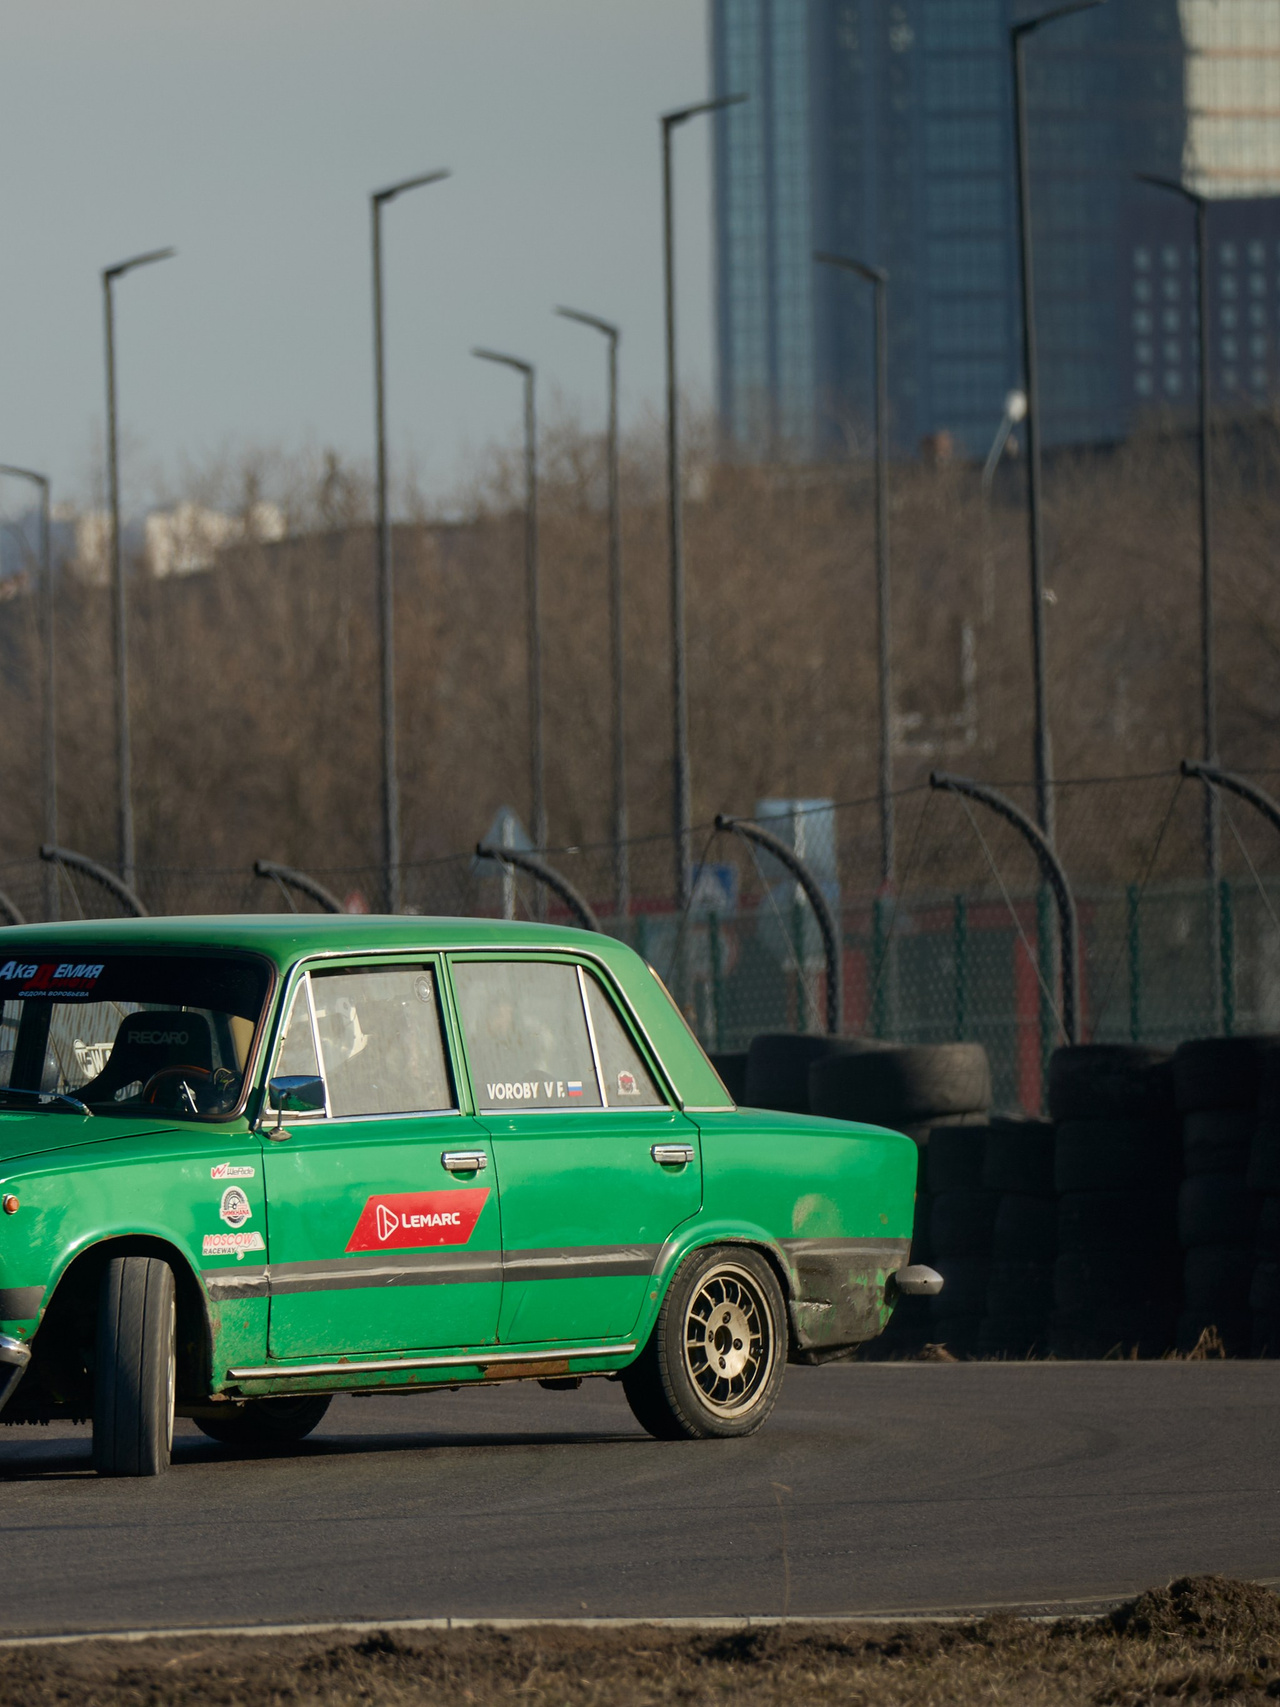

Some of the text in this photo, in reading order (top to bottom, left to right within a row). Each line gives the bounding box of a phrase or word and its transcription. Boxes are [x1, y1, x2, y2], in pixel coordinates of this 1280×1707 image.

[128, 1030, 189, 1046] RECARO
[401, 1212, 461, 1229] LEMARC
[203, 1233, 255, 1247] MOSCOW
[202, 1247, 237, 1255] RACEWAY
